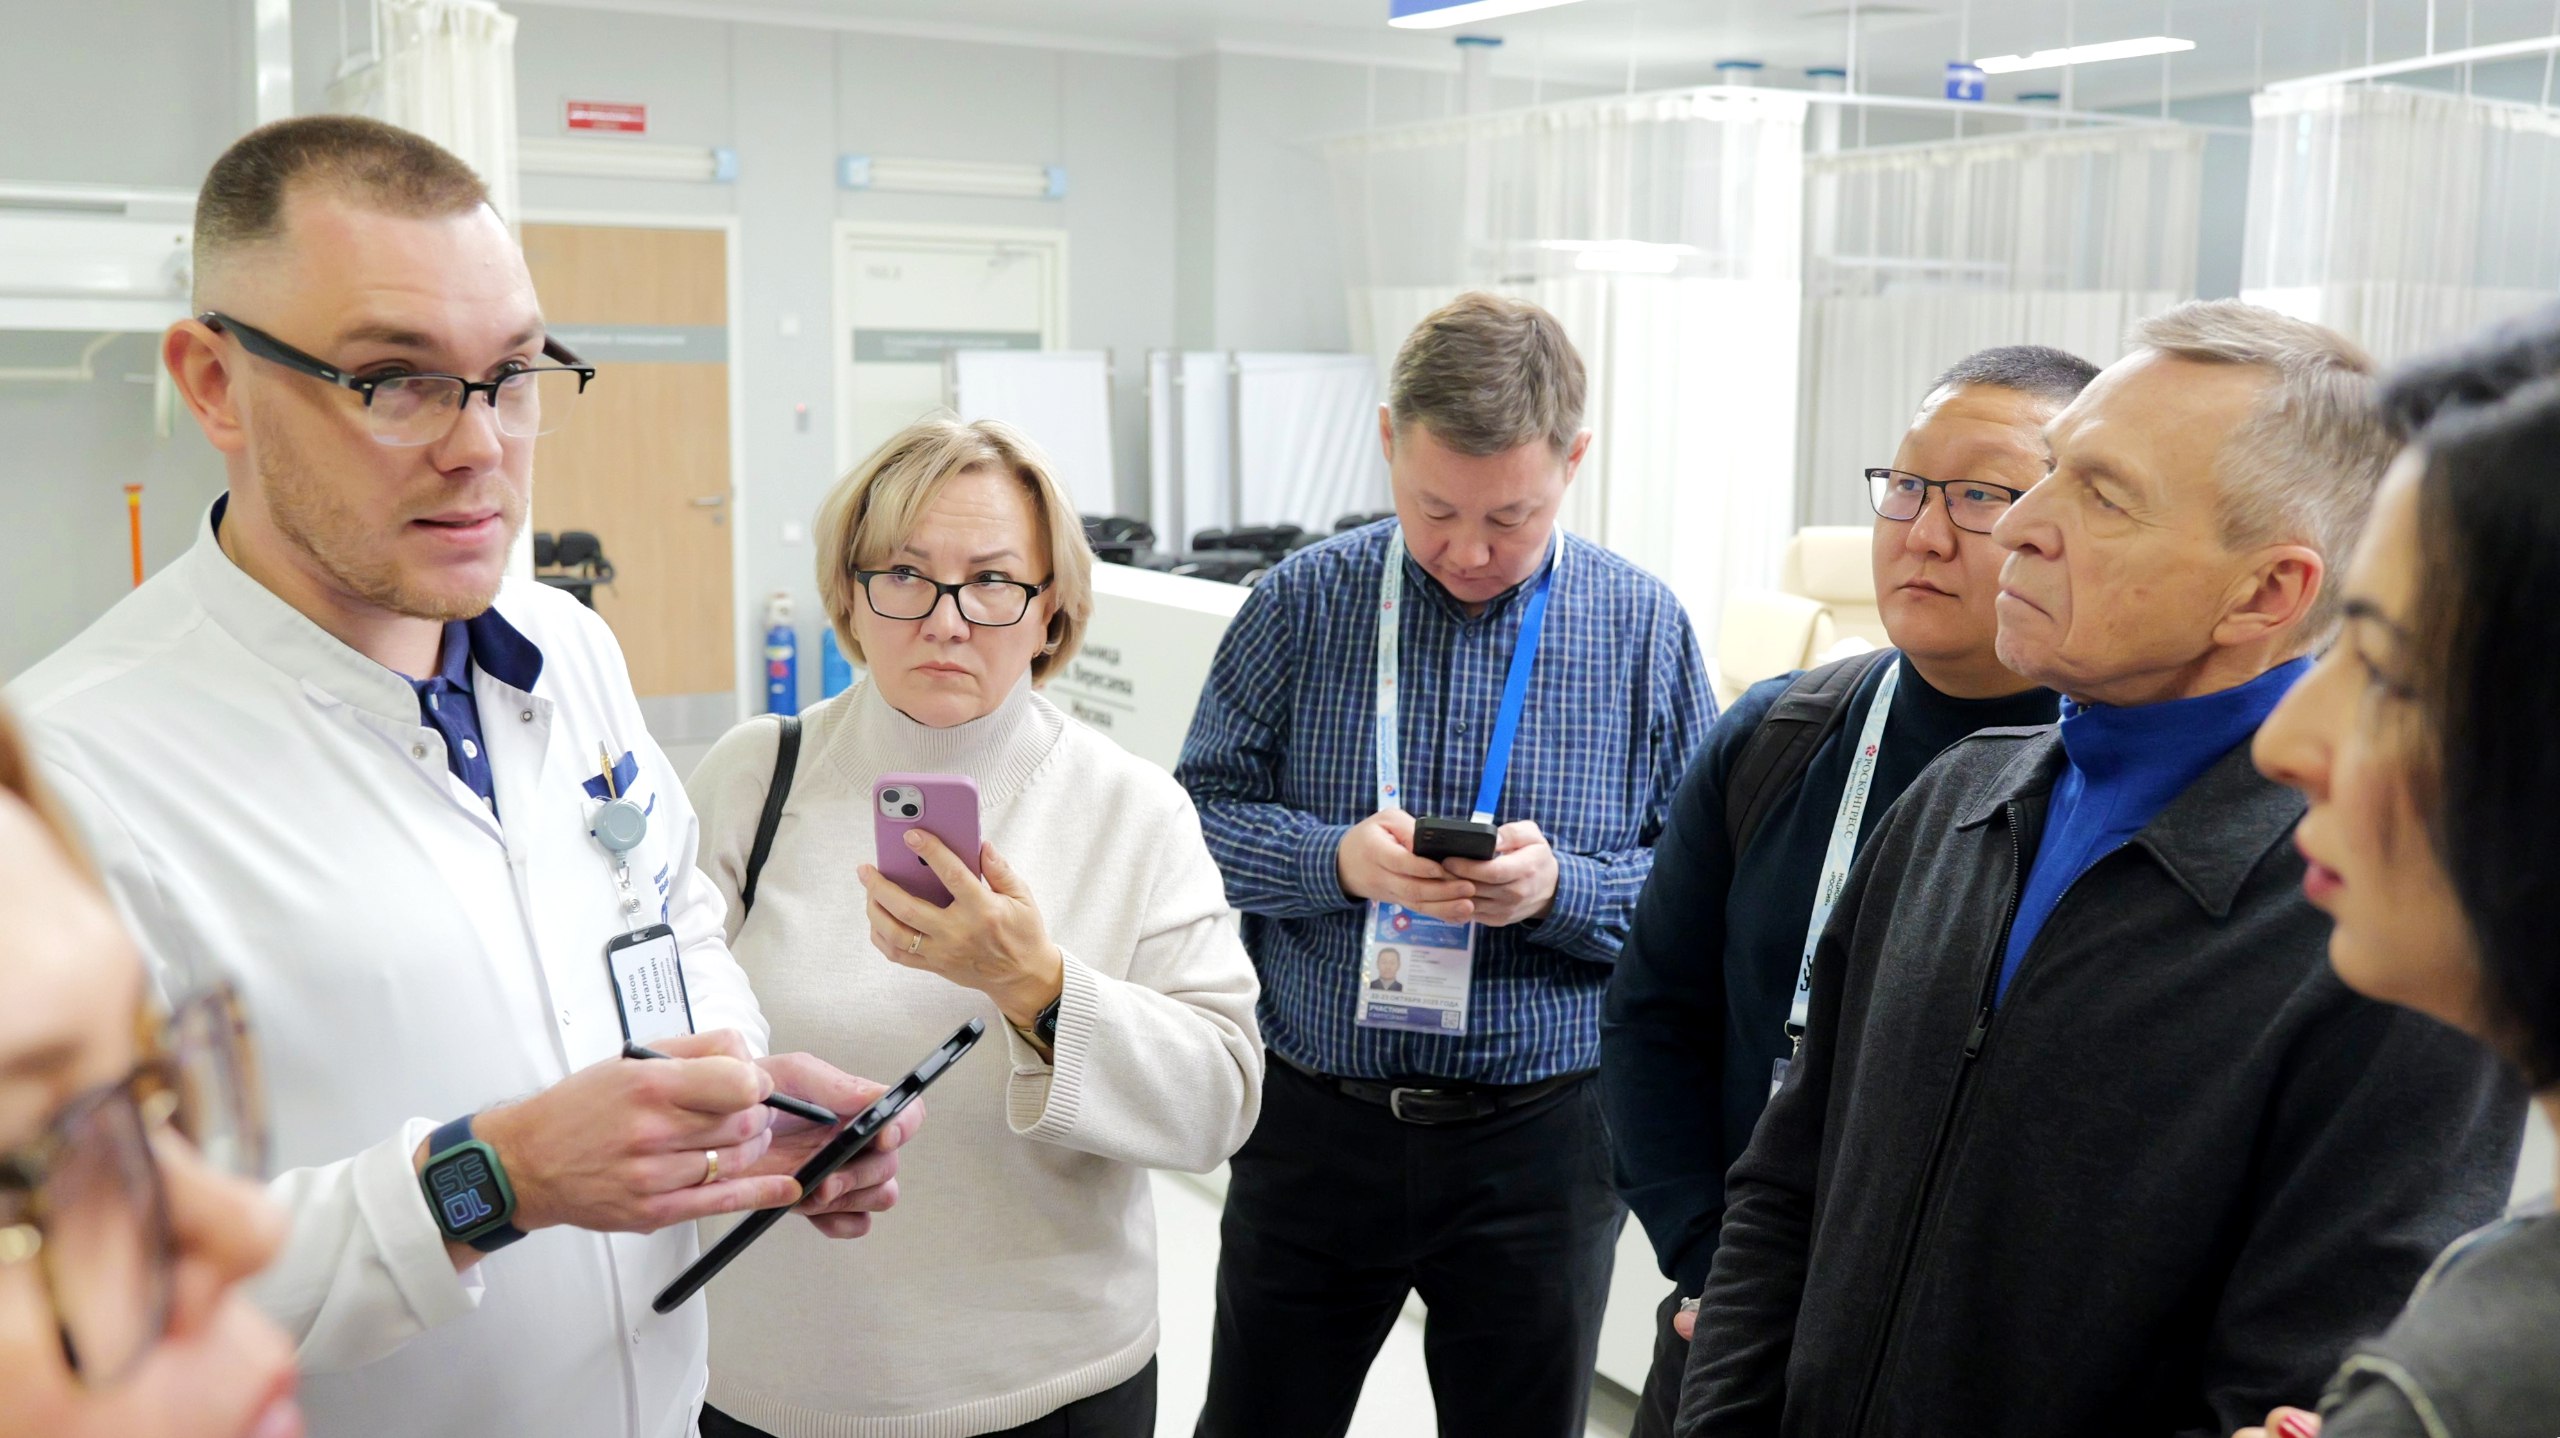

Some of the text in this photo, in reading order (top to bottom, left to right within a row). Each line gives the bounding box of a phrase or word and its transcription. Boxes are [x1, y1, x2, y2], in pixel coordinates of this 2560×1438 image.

[1844, 758, 1873, 840] РОСКОНГРЕСС
[628, 974, 641, 1014] Зубков
[638, 966, 654, 1013] Виталий
[650, 957, 666, 1014] Сергеевич
